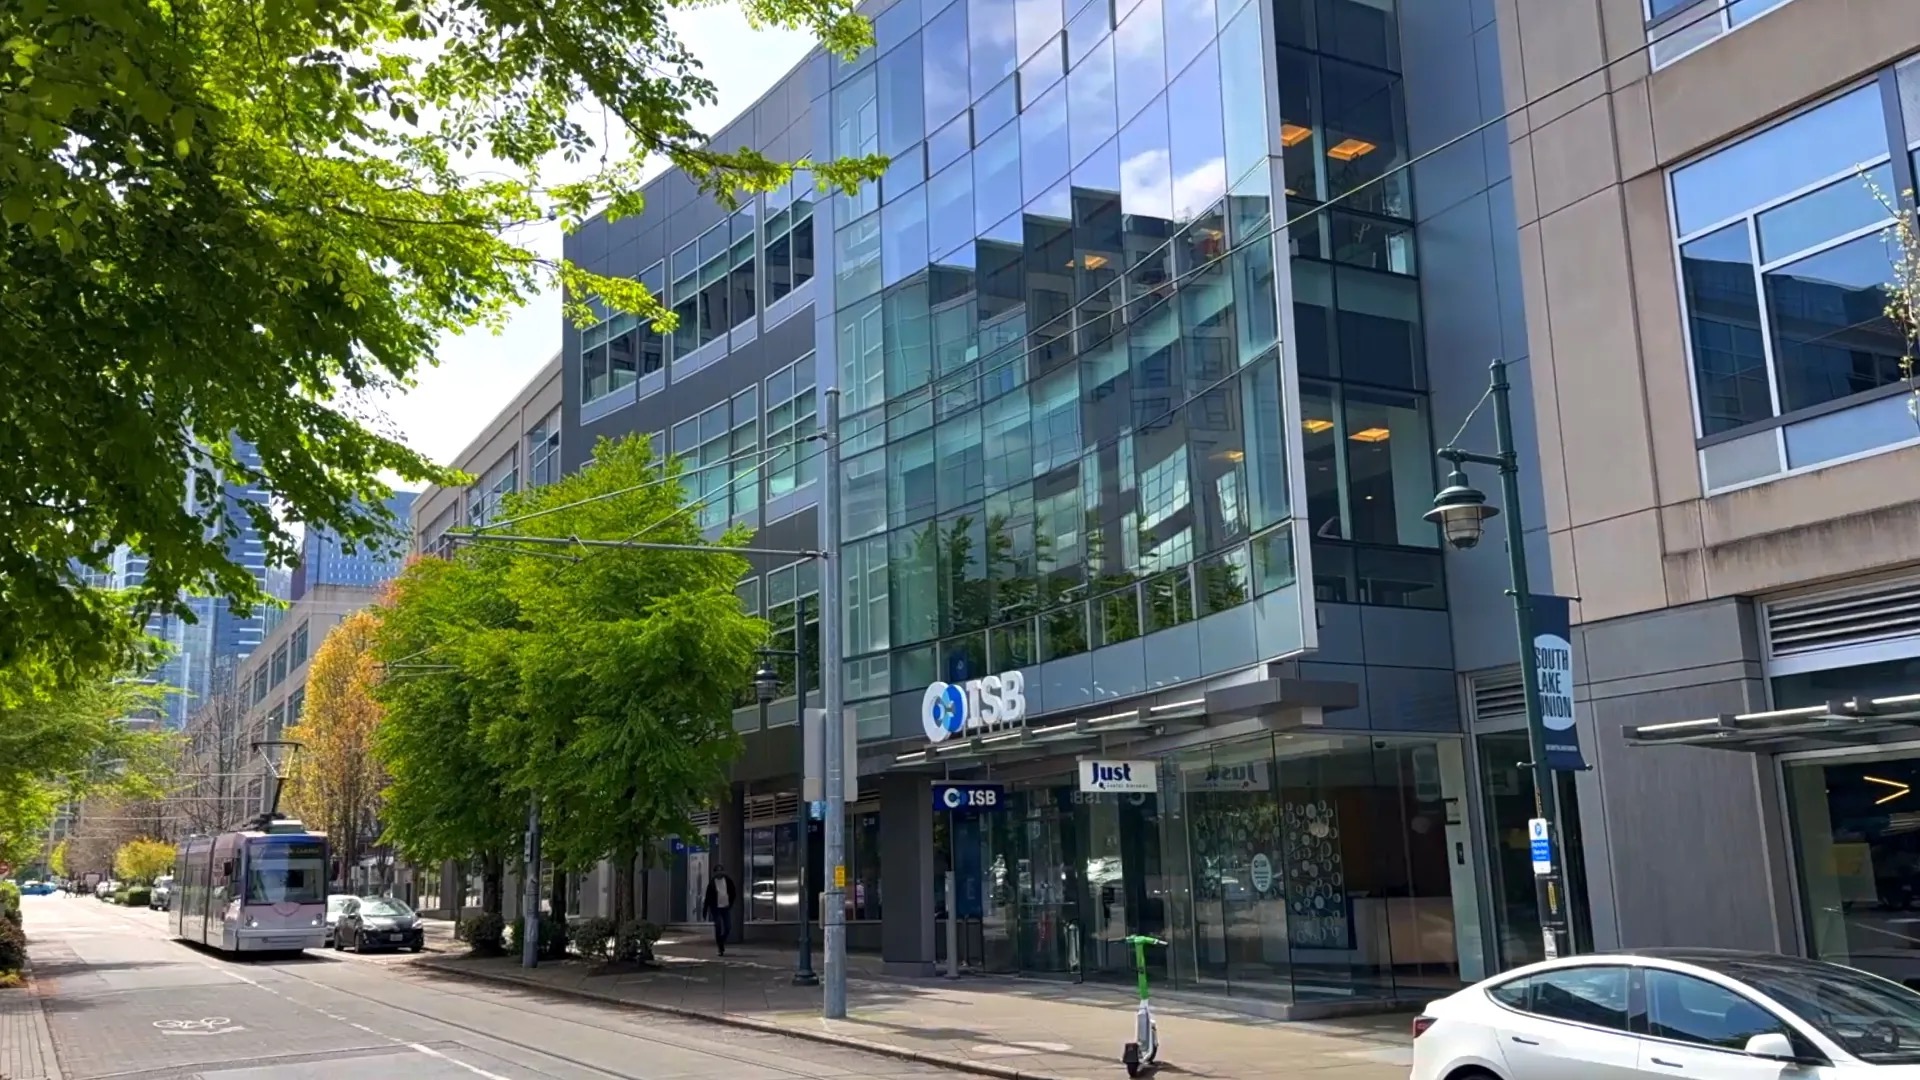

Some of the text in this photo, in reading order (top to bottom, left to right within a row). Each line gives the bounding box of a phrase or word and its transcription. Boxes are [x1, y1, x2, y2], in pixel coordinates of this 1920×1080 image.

[1535, 647, 1569, 671] SOUTH
[966, 670, 1026, 728] ISB
[1091, 762, 1132, 784] Just
[968, 790, 997, 806] ISB
